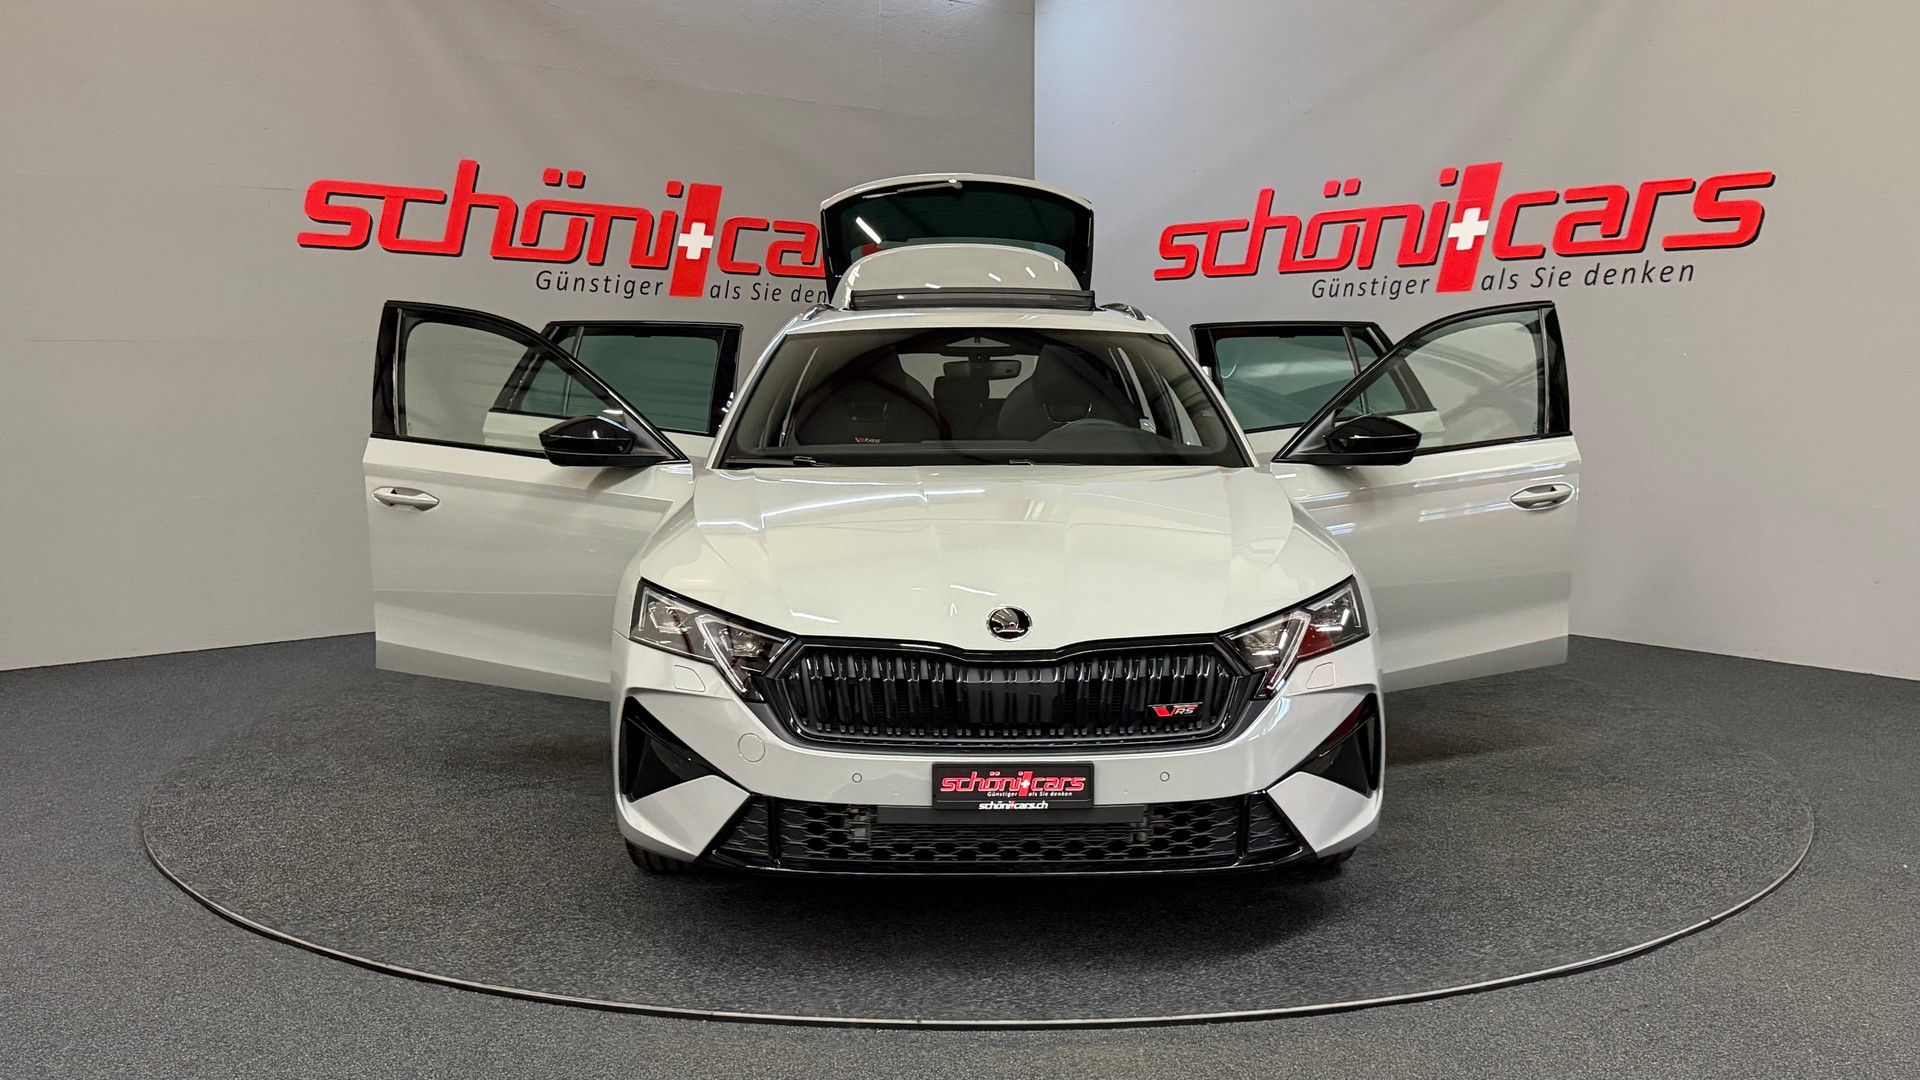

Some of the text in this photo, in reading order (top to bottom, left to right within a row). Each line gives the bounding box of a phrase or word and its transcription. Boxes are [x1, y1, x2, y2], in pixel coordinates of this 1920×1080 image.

[717, 216, 826, 278] ca
[535, 270, 828, 303] Günstiger als Sie den
[1311, 261, 1695, 299] Günstiger als Sie denken
